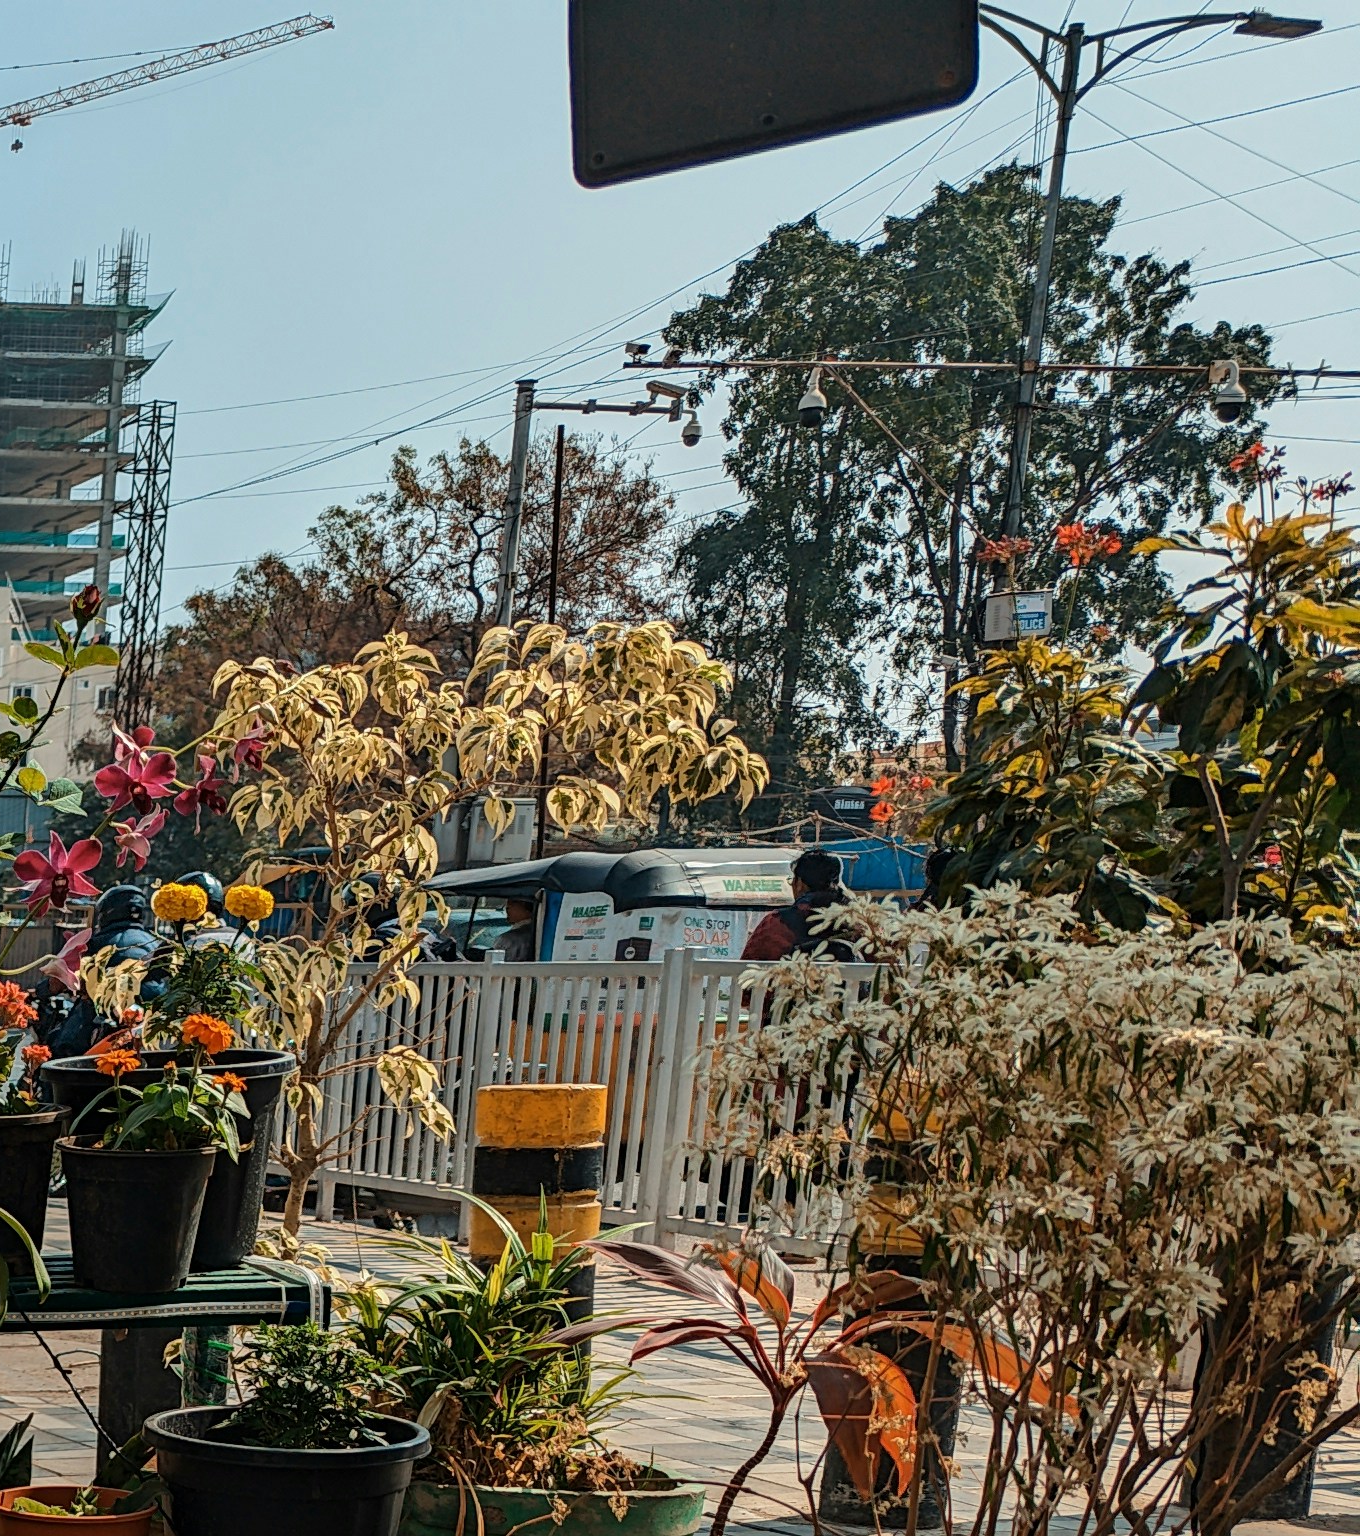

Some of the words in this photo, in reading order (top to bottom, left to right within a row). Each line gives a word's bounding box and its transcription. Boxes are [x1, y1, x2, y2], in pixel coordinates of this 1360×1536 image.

[1017, 618, 1044, 630] OLICE
[722, 879, 784, 892] WAAREE
[571, 904, 611, 918] WAAREE
[683, 916, 705, 929] ONE
[705, 919, 731, 930] STOP
[683, 927, 730, 946] SOLAR
